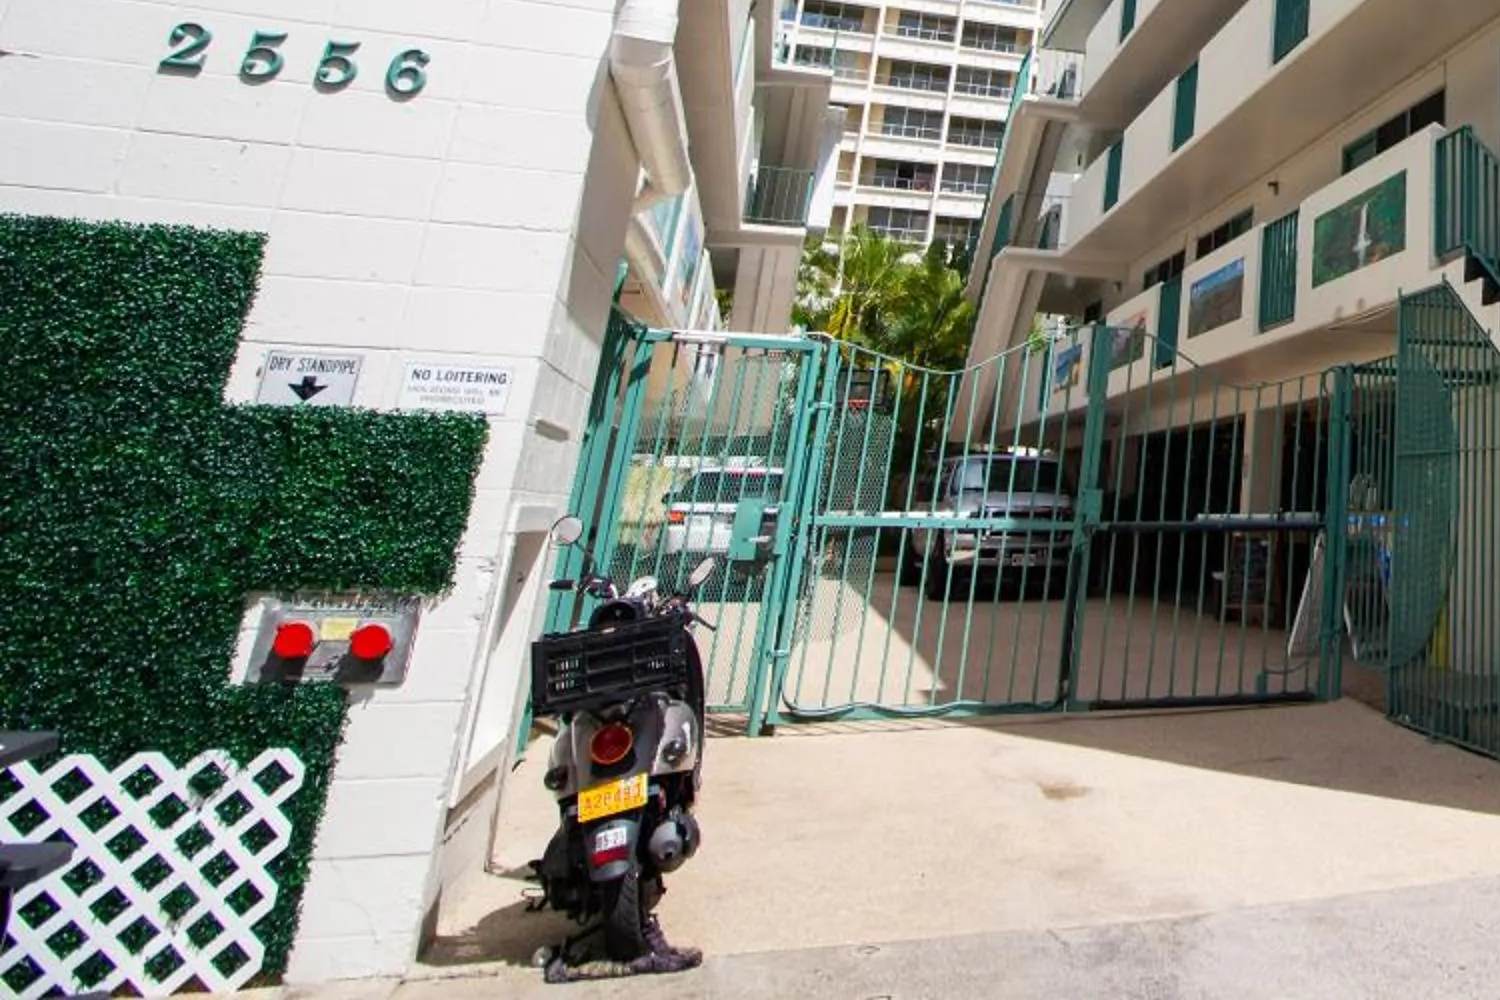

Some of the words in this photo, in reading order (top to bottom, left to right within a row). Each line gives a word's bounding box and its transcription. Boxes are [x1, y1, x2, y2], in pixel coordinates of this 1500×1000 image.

[157, 21, 431, 99] 2556
[268, 355, 293, 372] DRY
[297, 357, 358, 376] STANDPIPE
[411, 368, 432, 381] NO
[436, 369, 508, 385] LOITERING
